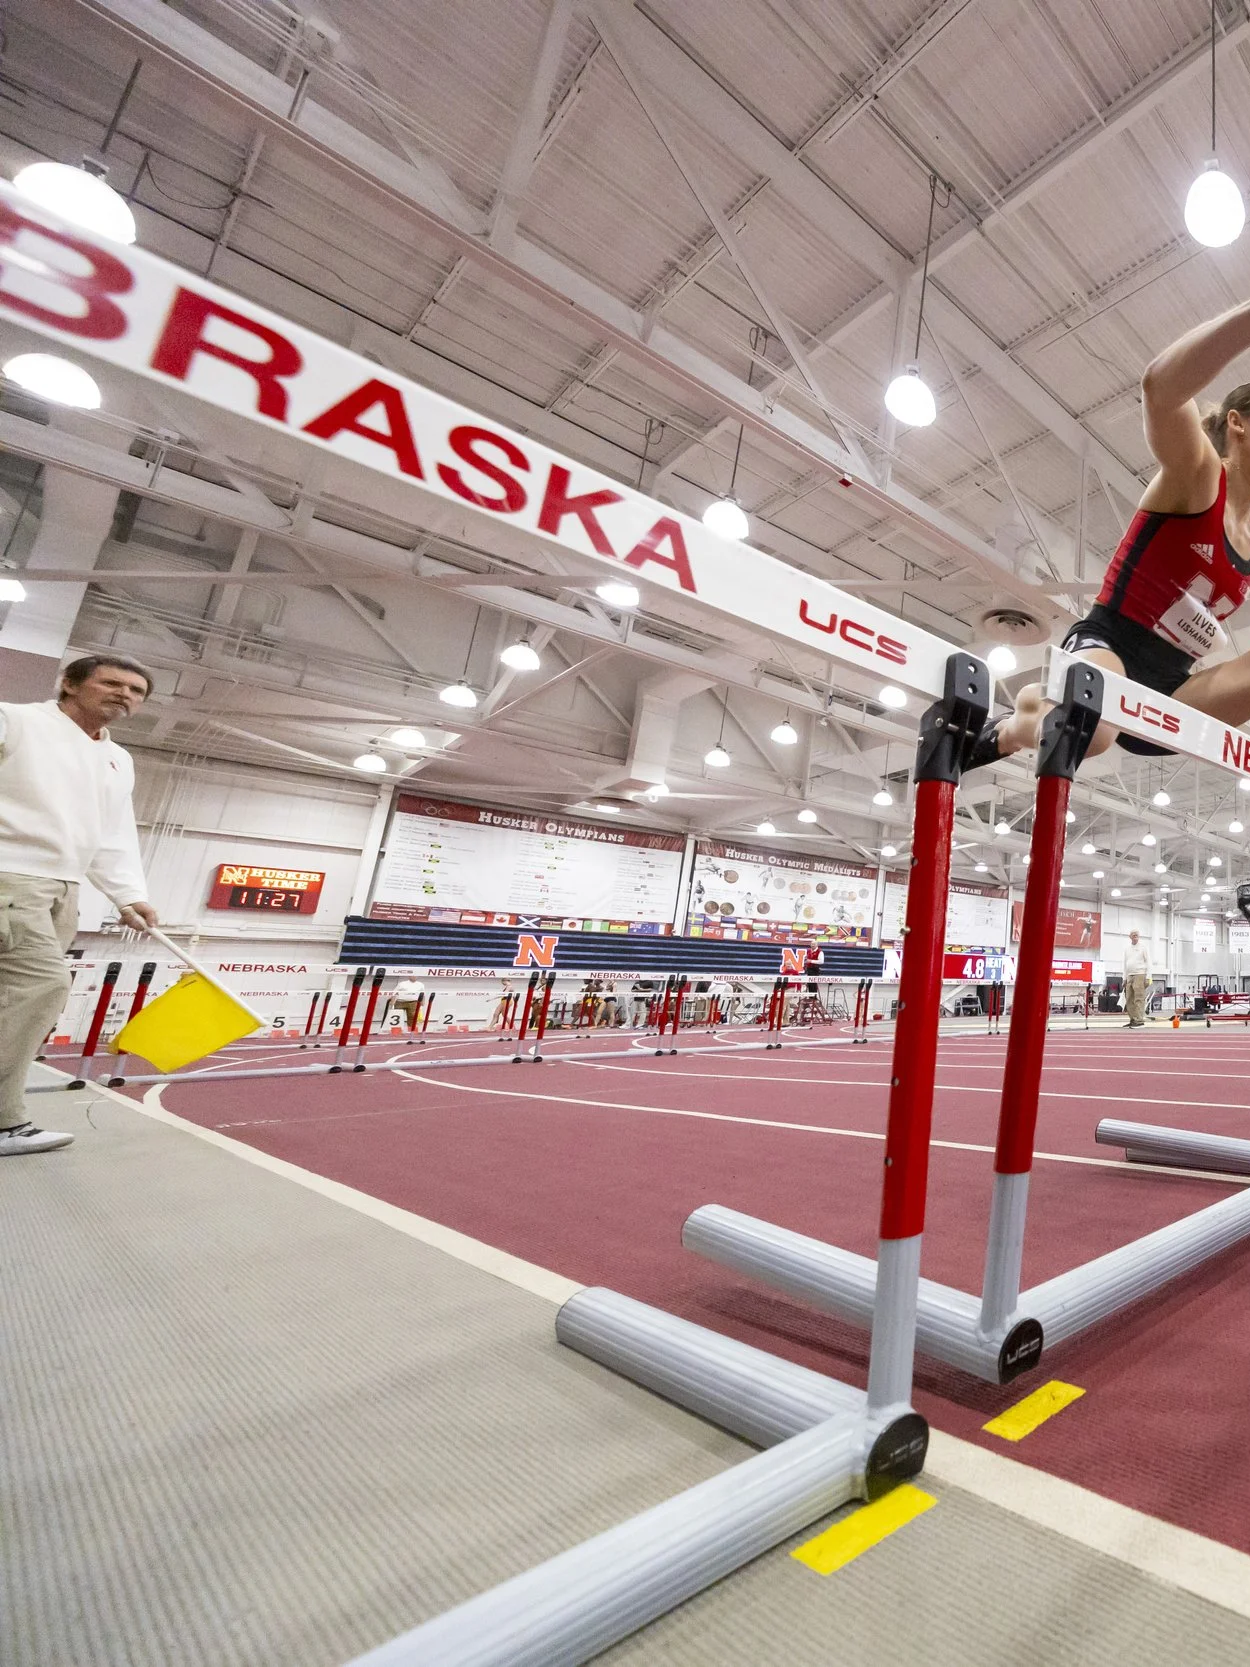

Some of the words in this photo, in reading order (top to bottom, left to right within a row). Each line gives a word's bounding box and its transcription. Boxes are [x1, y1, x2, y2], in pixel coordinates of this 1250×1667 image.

[1190, 543, 1213, 565] adidas
[800, 598, 909, 666] UCS
[1192, 612, 1217, 637] ILVES
[1177, 618, 1212, 650] LISHANNA
[1120, 695, 1180, 734] UCS
[478, 811, 538, 830] HUSKER
[546, 822, 625, 844] OLYMPIANS
[725, 848, 764, 863] HUSKER
[768, 856, 810, 870] OLYMPIC
[814, 863, 861, 876] MEDALISTS
[250, 868, 320, 882] HUSKER
[261, 878, 308, 890] TIME
[240, 891, 300, 908] 11:27
[514, 934, 559, 968] N
[219, 963, 307, 973] NEBRASKA
[781, 948, 807, 974] N
[963, 958, 984, 978] 4.8
[986, 958, 1002, 968] HEAT
[428, 968, 496, 977] NEBRASKA
[991, 969, 996, 978] 3
[272, 1016, 285, 1027] 5
[330, 1016, 341, 1027] 4
[390, 1016, 400, 1025] 3
[444, 1014, 454, 1024] 2
[1007, 1338, 1040, 1364] UCS
